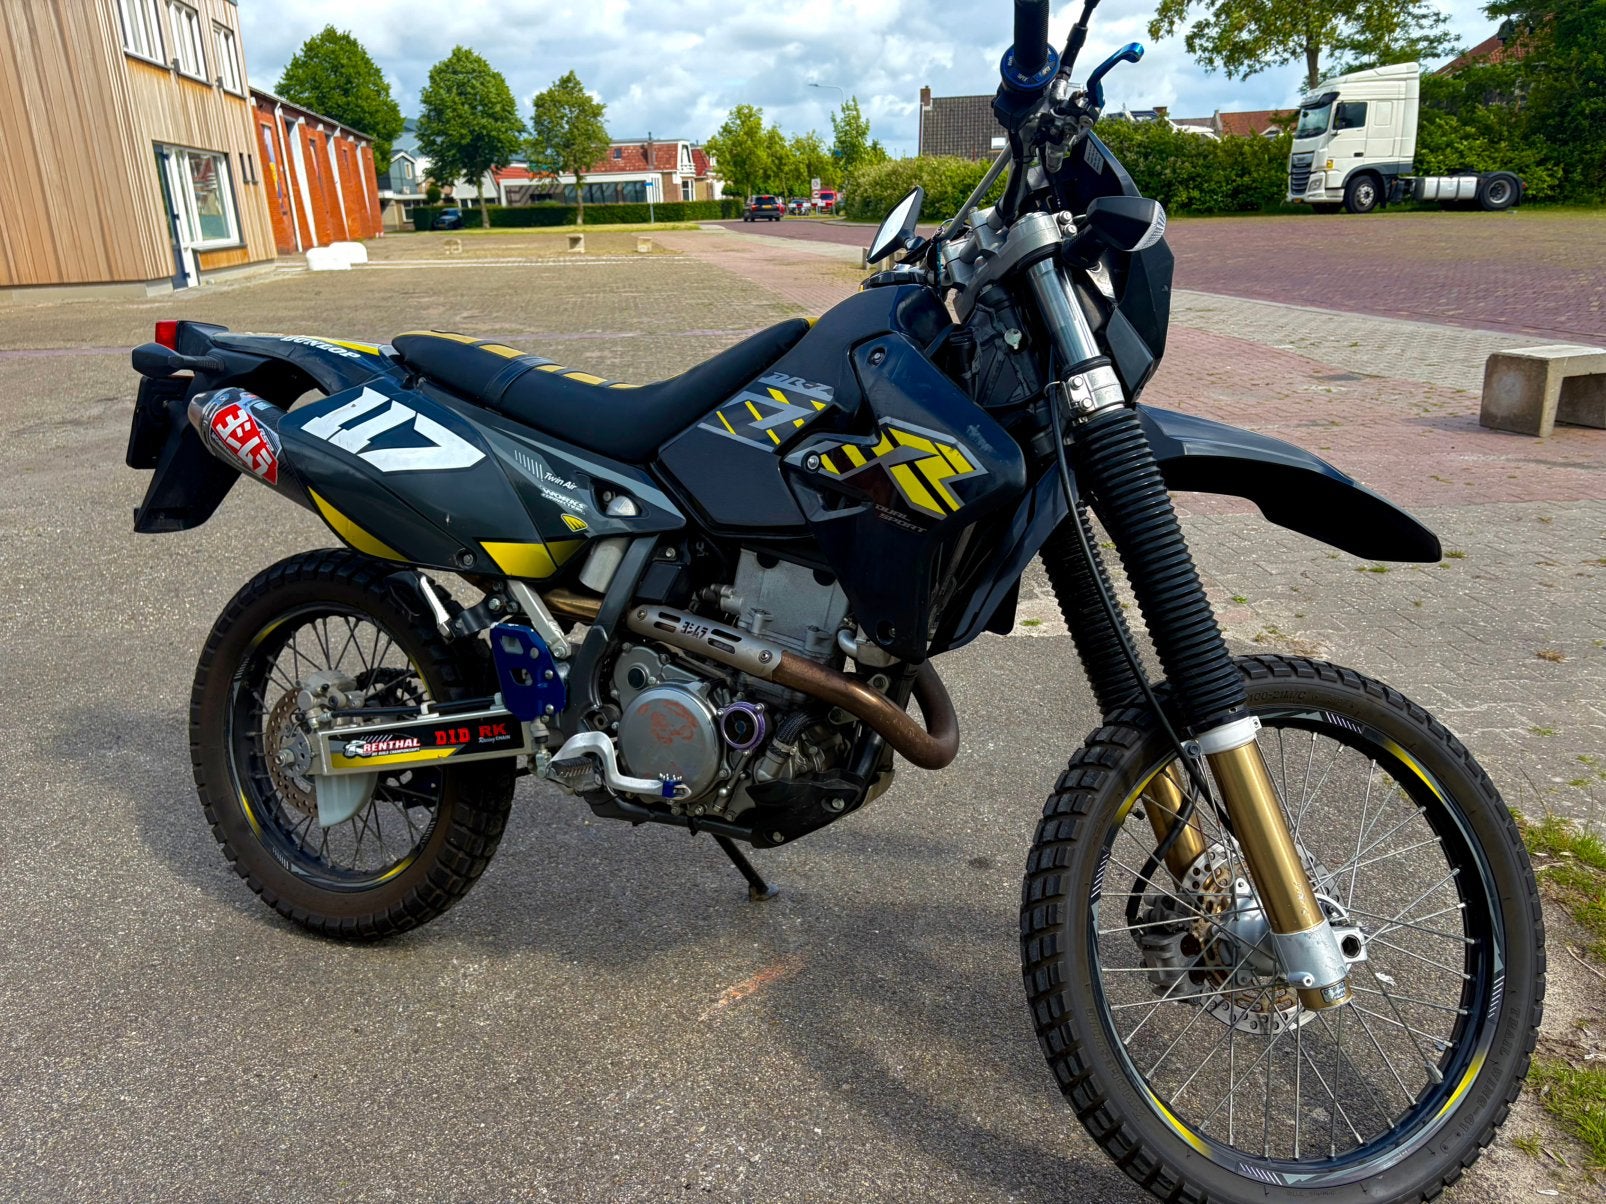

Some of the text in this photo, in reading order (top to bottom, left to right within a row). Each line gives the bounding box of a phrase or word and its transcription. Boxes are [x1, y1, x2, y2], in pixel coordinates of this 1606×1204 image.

[280, 336, 362, 358] DUNLOP
[301, 386, 487, 473] 117
[215, 408, 273, 476] ヨシムラ
[543, 472, 578, 490] Twin Air
[875, 504, 912, 522] DUAL
[680, 621, 709, 640] ヨシムラ
[478, 723, 507, 737] RK
[363, 737, 421, 752] RENTHAL
